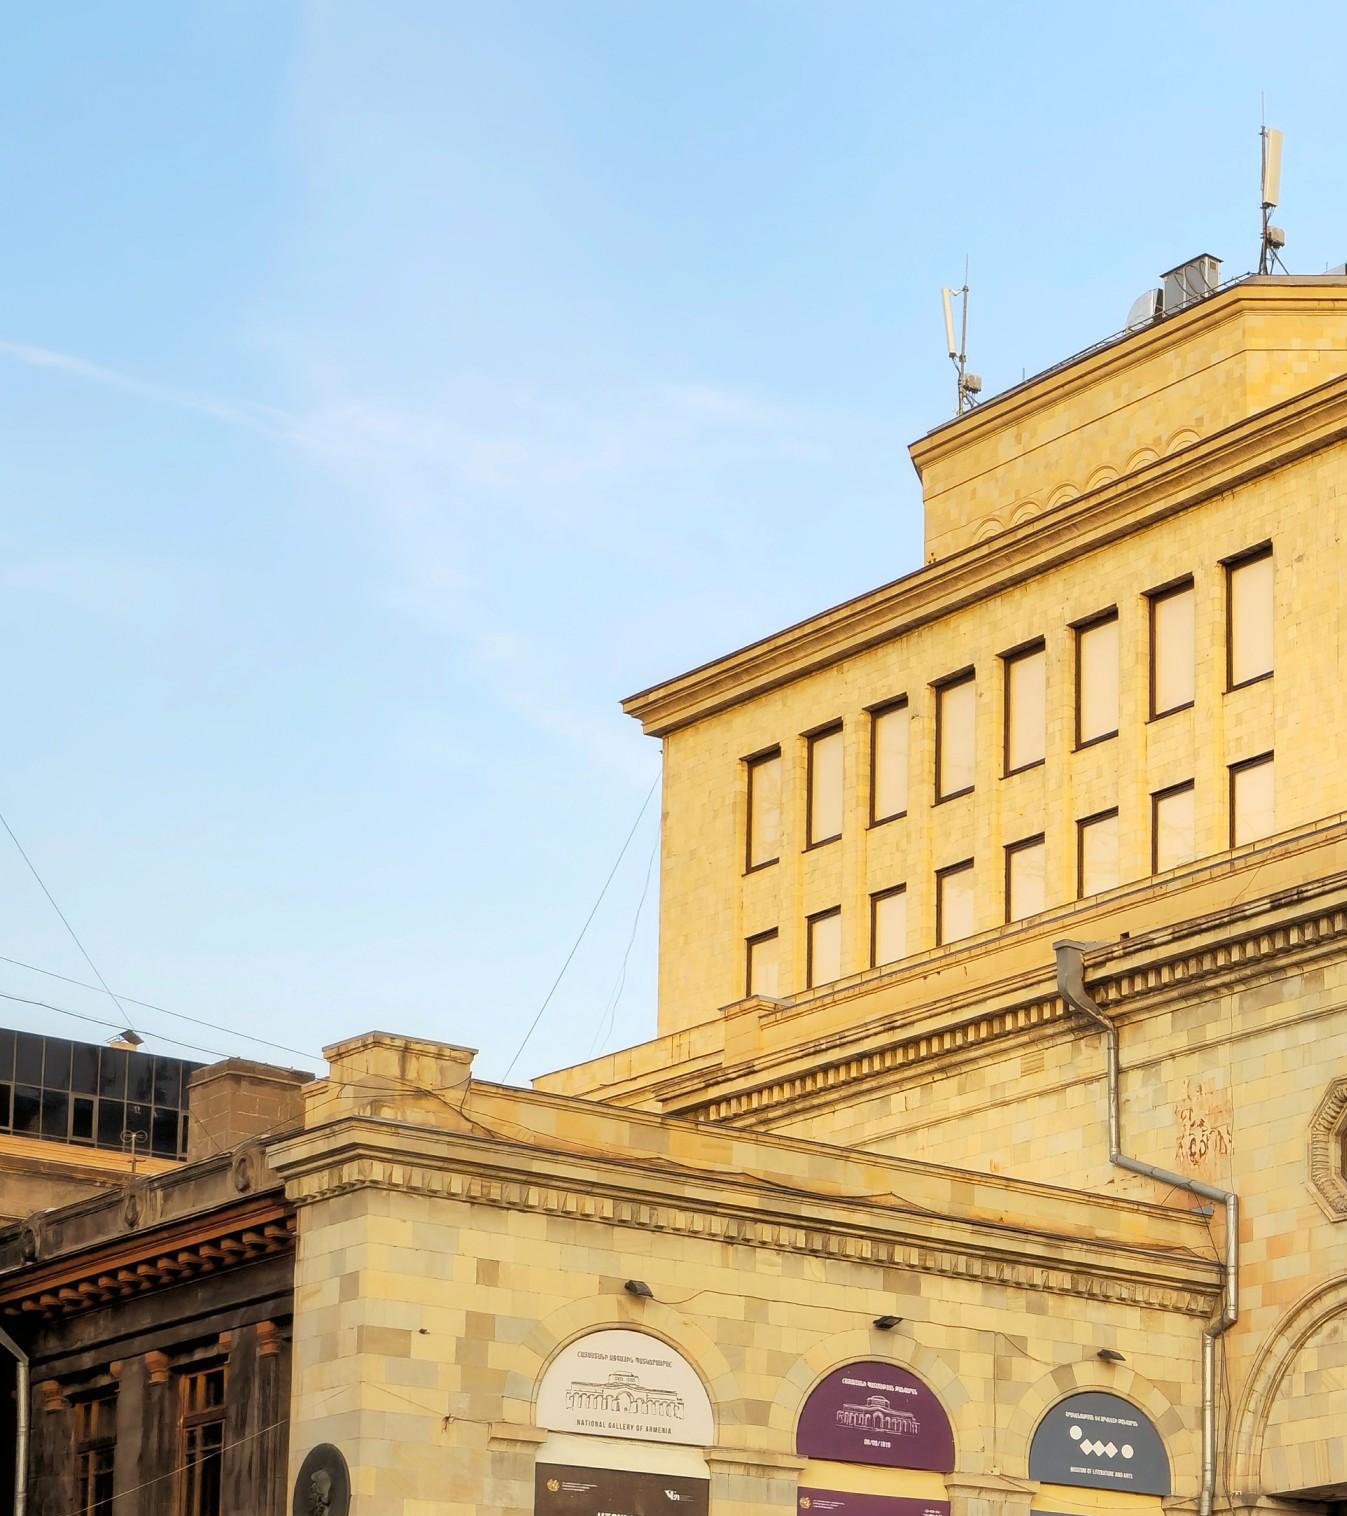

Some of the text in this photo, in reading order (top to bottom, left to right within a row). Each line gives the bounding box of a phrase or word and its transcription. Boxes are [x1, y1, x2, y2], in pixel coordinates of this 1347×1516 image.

[576, 1419, 606, 1429] NATIONAL
[608, 1422, 634, 1431] GALLERY
[645, 1426, 672, 1434] ARMENIA
